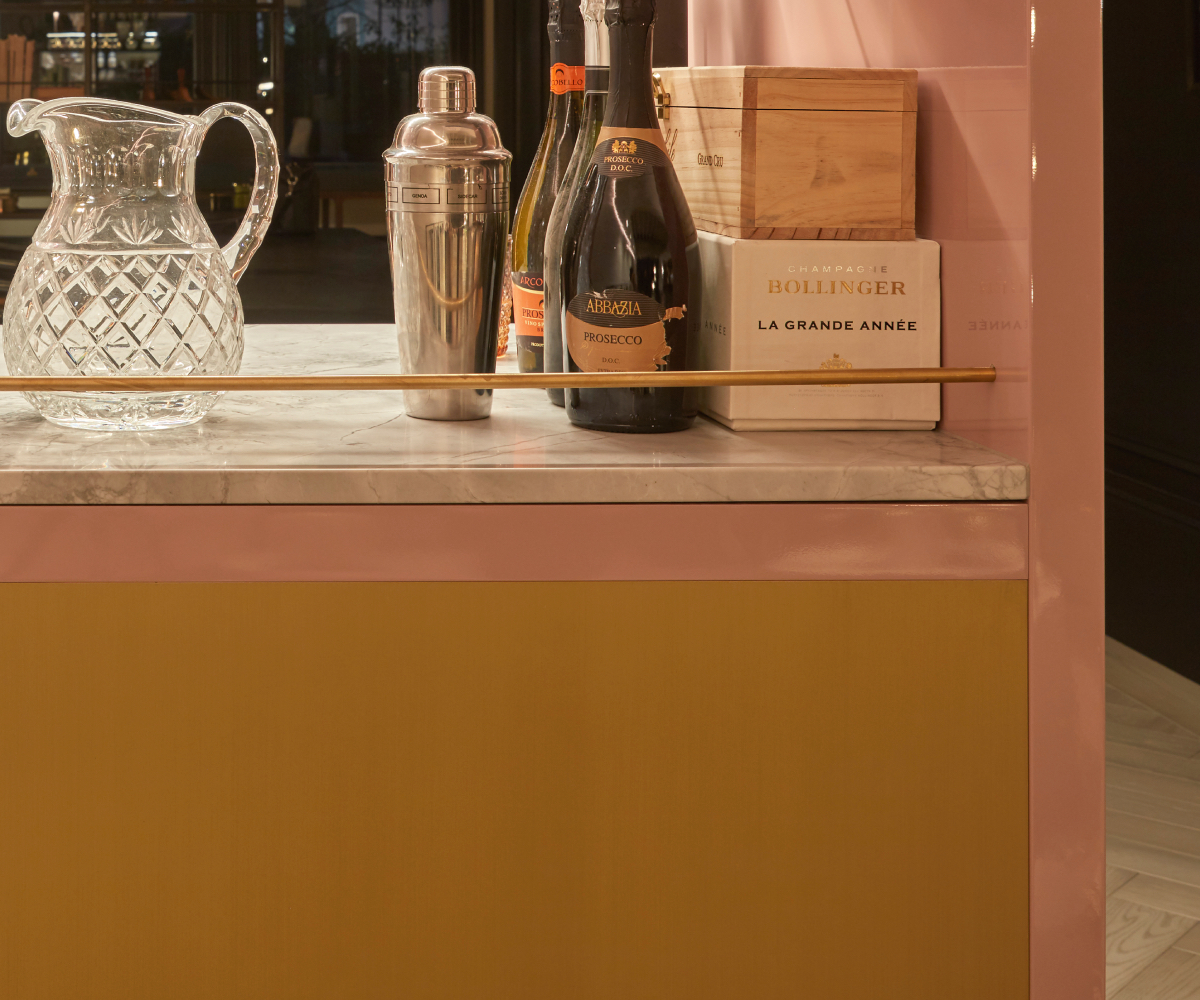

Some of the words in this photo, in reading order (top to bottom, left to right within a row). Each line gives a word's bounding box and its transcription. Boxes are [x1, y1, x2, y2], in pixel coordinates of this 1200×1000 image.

[603, 155, 644, 165] PROSECCO
[610, 164, 633, 172] D.O.C.
[788, 265, 888, 273] CHAMPAGNE
[768, 279, 906, 295] BOLLINGER
[586, 298, 642, 318] ABBAZIA
[758, 320, 779, 330] LA
[784, 320, 854, 331] GRANDE
[860, 318, 917, 331] ANNÉE
[583, 332, 643, 345] PROSECCO
